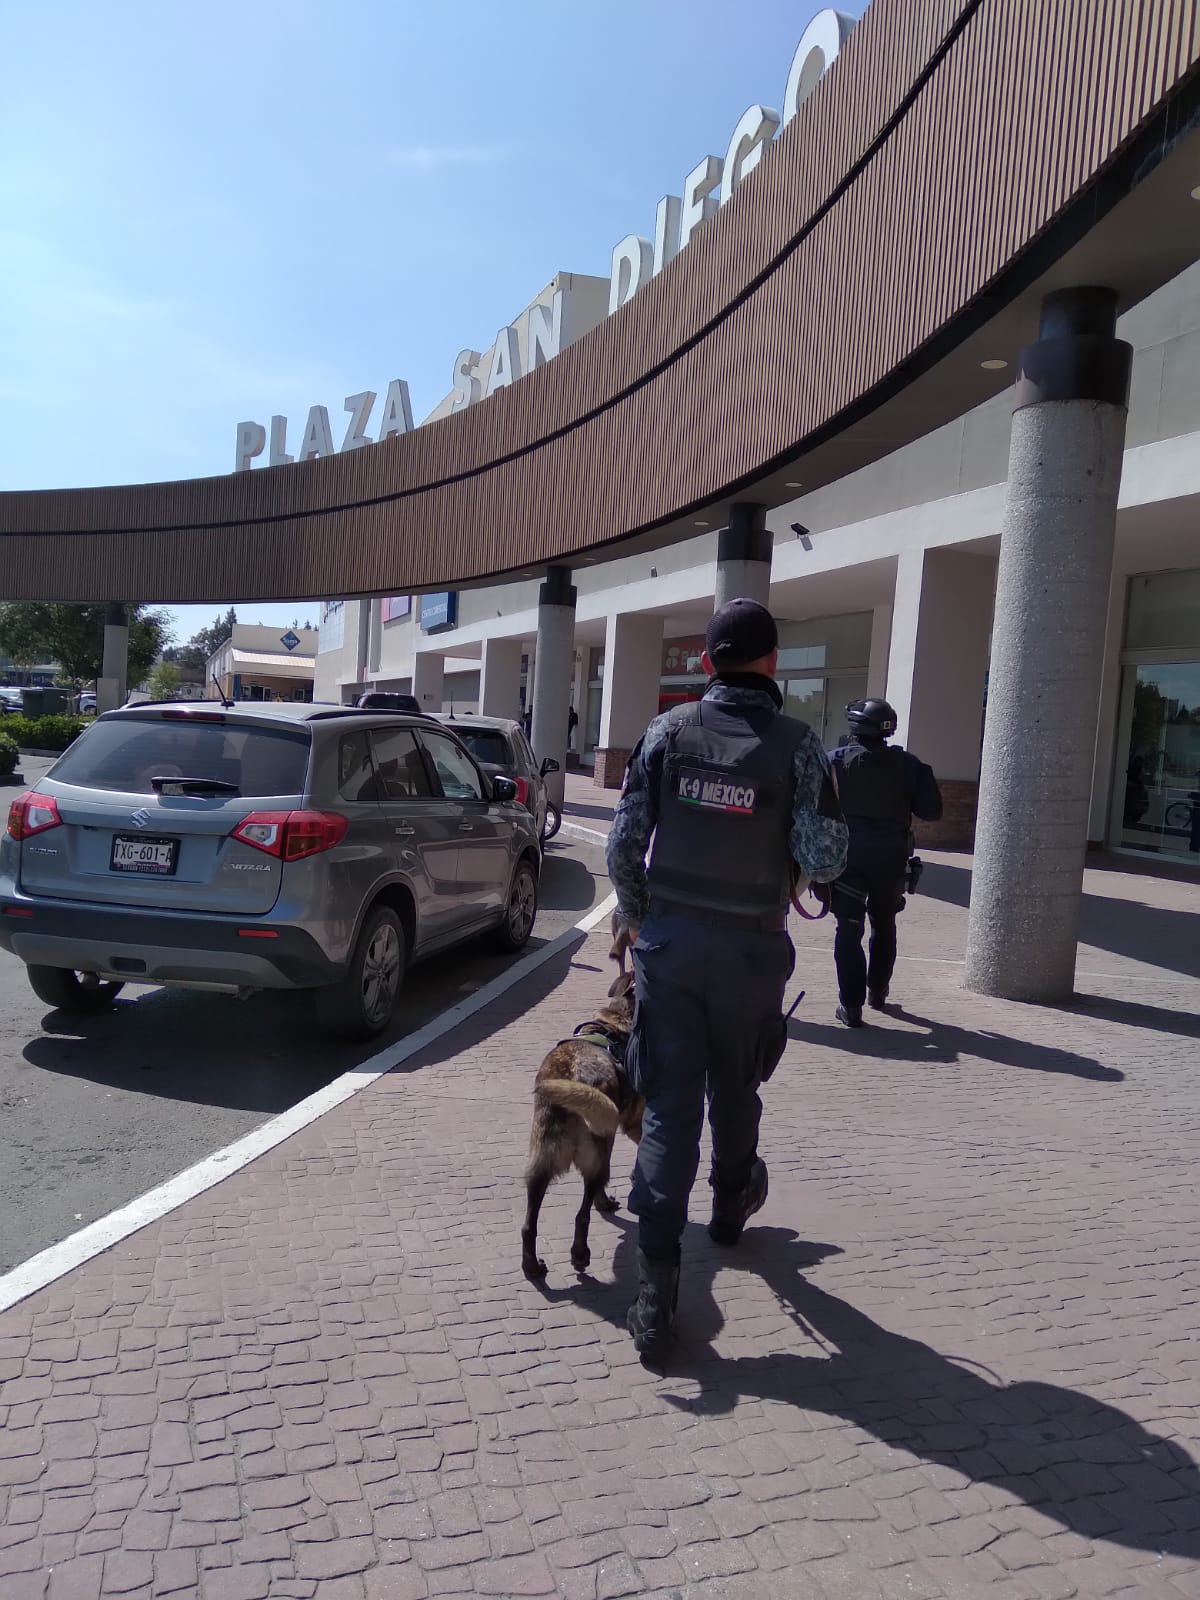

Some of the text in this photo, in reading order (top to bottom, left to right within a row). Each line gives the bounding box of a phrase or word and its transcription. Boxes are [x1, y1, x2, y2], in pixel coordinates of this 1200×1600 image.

[235, 379, 415, 472] PLAZA
[451, 288, 566, 413] SAN
[679, 777, 755, 808] K-9 MÉXICO
[114, 843, 172, 863] TXG-601-A
